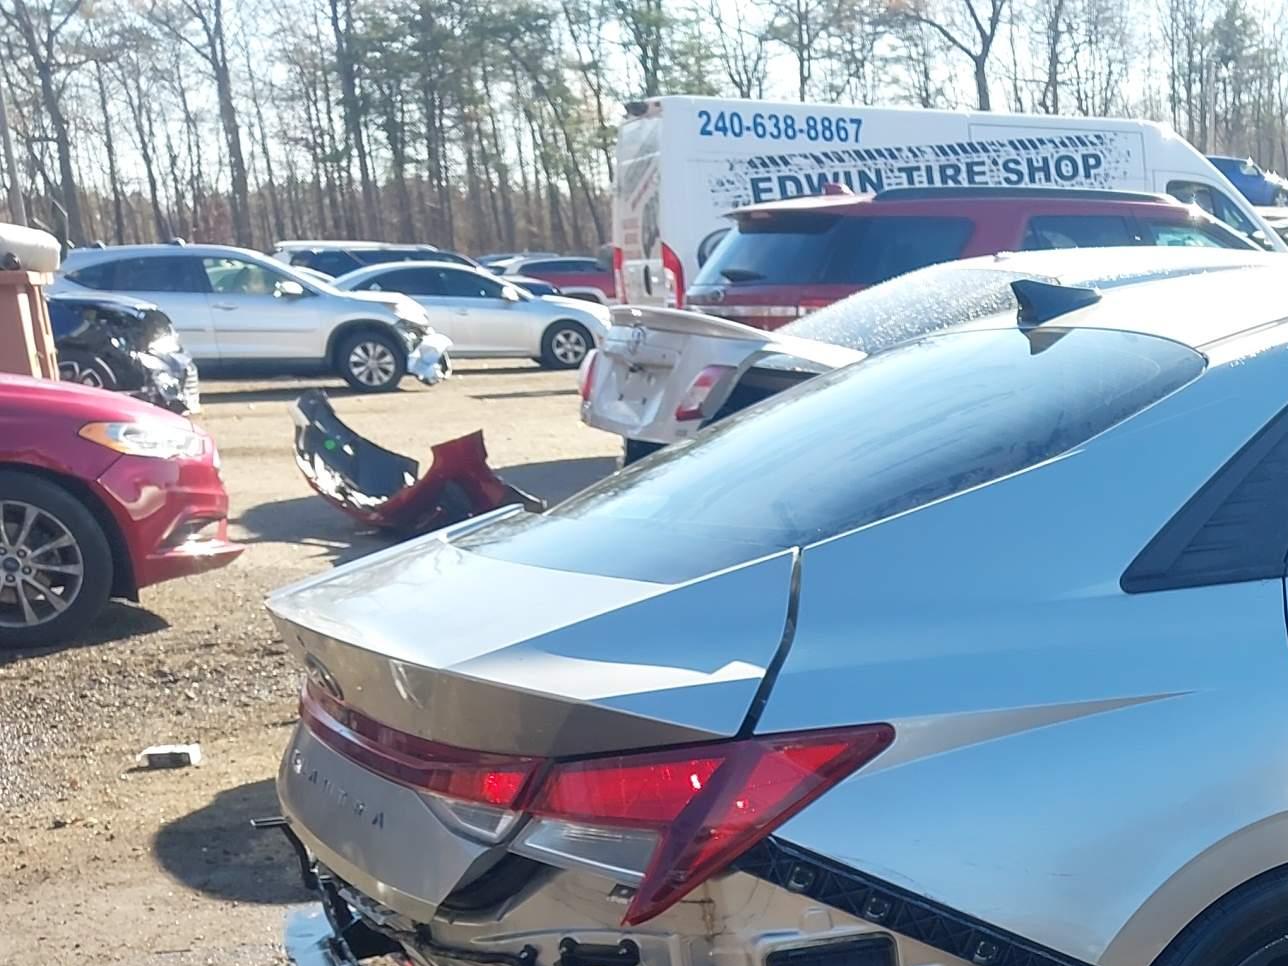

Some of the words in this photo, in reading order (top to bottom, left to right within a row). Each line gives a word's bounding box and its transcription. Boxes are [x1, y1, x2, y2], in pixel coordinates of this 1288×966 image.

[698, 110, 862, 143] 240-638-8867
[751, 167, 884, 203] EDWIN
[898, 160, 986, 186] TIRE
[1002, 152, 1101, 186] SHOP
